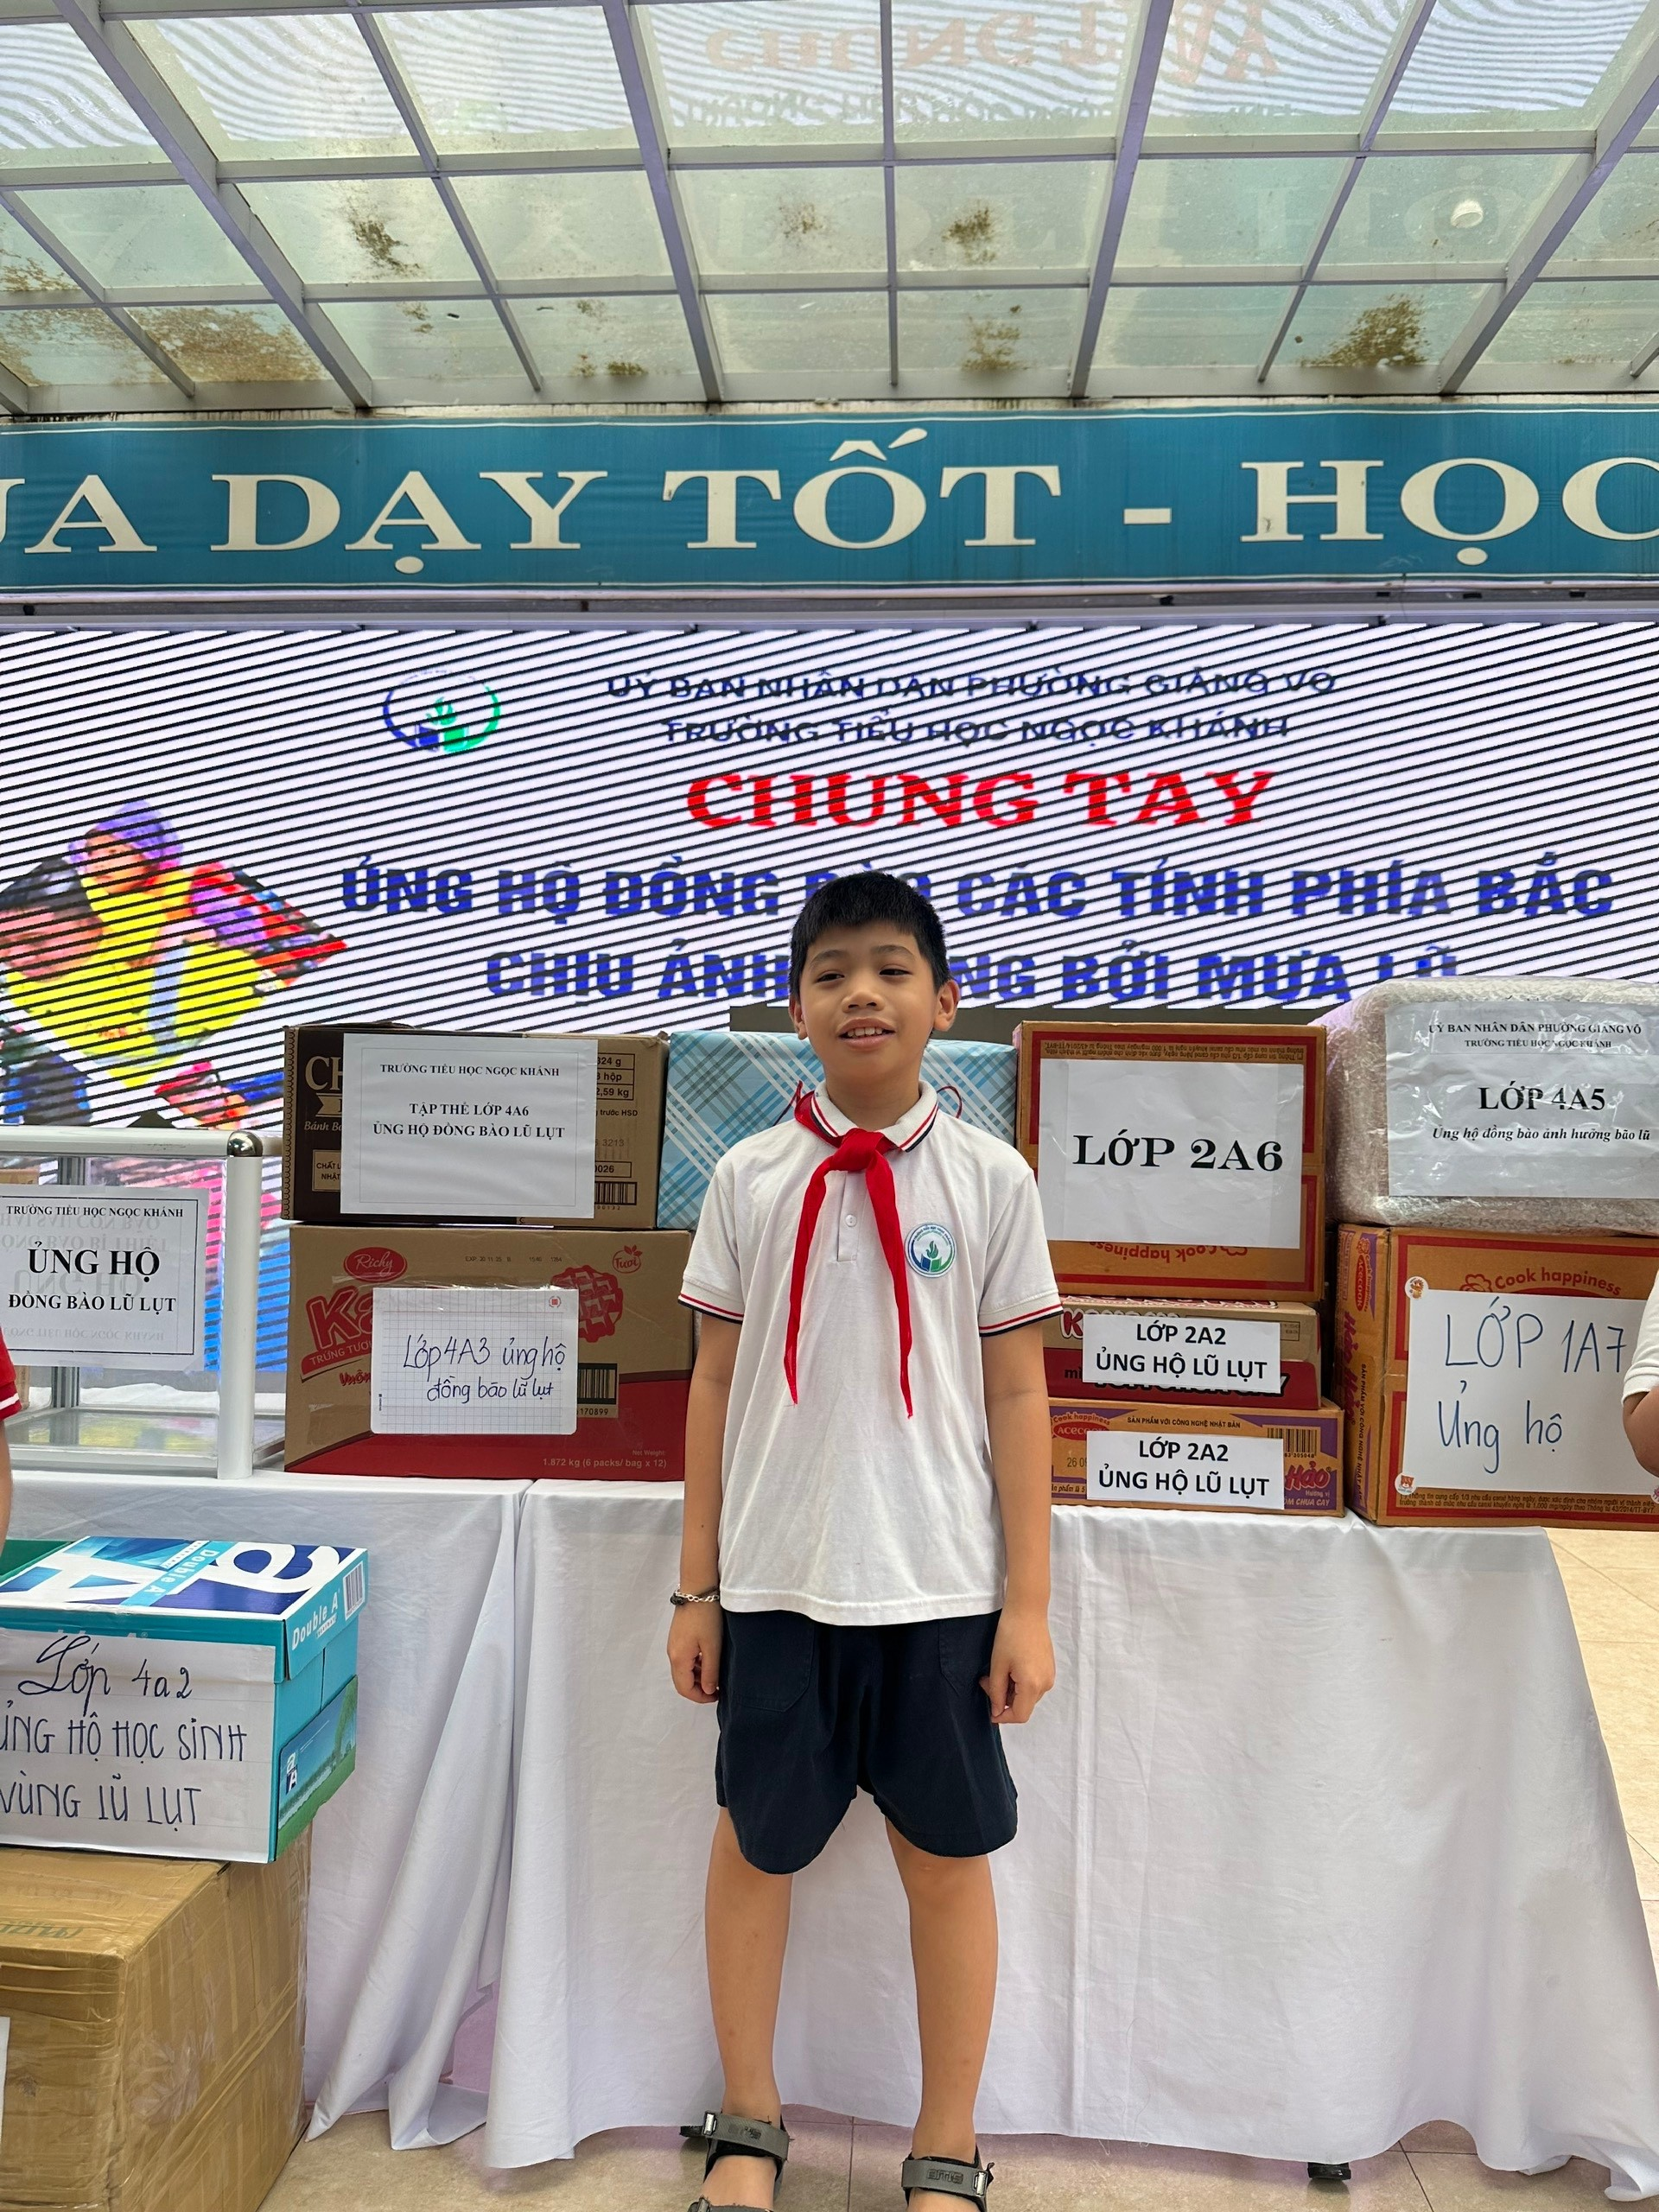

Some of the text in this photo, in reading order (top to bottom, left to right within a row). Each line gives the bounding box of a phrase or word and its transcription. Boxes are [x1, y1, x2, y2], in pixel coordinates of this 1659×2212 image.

[211, 470, 608, 575] DẠY
[661, 427, 1061, 550] TỐT
[1241, 457, 1659, 566] HỌC
[668, 677, 746, 699] BAN
[758, 669, 865, 699] NHÂN
[967, 667, 1130, 696] PHƯỜNG
[664, 709, 1288, 747] TRƯỜNG TIỂU HỌC NGỌC KHÁNH
[688, 770, 1278, 829] CHUNG TAY
[495, 862, 582, 924] HỘ
[604, 855, 780, 917] ĐỒNG
[957, 862, 1086, 916] CÁC
[1292, 861, 1452, 916] PHÍA
[1476, 851, 1614, 917] BẮC
[1060, 940, 1169, 1001] BỞI
[1197, 950, 1352, 1002] MƯA
[1447, 1024, 1471, 1033] BAN
[1474, 1020, 1507, 1033] NHÂN
[1510, 1020, 1535, 1033] DÂN
[1538, 1021, 1586, 1033] PHƯỜNG
[1627, 1023, 1642, 1034] VÕ
[1465, 1037, 1504, 1047] TRƯỜNG
[1531, 1039, 1551, 1049] HỌC
[380, 1063, 428, 1074] TRƯỜNG
[458, 1065, 483, 1077] HỌC
[486, 1066, 518, 1077] NGỌC
[519, 1065, 560, 1077] KHÁNH
[615, 1058, 621, 1067] g
[604, 1072, 622, 1085] hộp
[596, 1087, 630, 1099] 2,59 kg
[1478, 1080, 1605, 1111] LỚP 4A5
[410, 1102, 438, 1117] TẬP
[474, 1102, 502, 1116] LỚP
[505, 1105, 530, 1116] 4A6
[304, 1121, 329, 1131] Bánh
[373, 1121, 565, 1141] ỦNG HỘ ĐỒNG BÀO LŨ LỤT
[1463, 1127, 1479, 1141] hộ
[1483, 1124, 1514, 1141] đồng
[1516, 1128, 1539, 1139] bào
[1571, 1128, 1611, 1142] hưởng
[1614, 1128, 1636, 1140] bão
[1638, 1128, 1651, 1140] lũ
[1071, 1128, 1284, 1172] LỚP 2A6
[316, 1160, 336, 1170] CHẤT
[6, 1204, 53, 1216] TRƯỜNG
[83, 1207, 107, 1218] HỌC
[109, 1207, 142, 1219] NGỌC
[143, 1205, 184, 1217] KHÁNH
[28, 1240, 161, 1283] ỦNG HỘ
[353, 1250, 395, 1277] Richy
[1495, 1266, 1622, 1296] Cook happiness
[9, 1290, 177, 1316] ĐỒNG BÀO LŨ LỤT
[1136, 1320, 1227, 1345] LỚP 2A2
[1445, 1295, 1627, 1374] LỚP 1A7
[309, 1344, 346, 1366] TRỨNG
[404, 1333, 442, 1382] Lớp
[443, 1336, 491, 1365] 4A3
[542, 1336, 567, 1371] hộ
[1096, 1346, 1268, 1382] ỦNG HỘ LŨ LỤT
[426, 1375, 471, 1404] đồng
[512, 1377, 528, 1399] lũ
[531, 1377, 554, 1401] lụt
[1053, 1412, 1110, 1425] Cook happiness
[1172, 1418, 1190, 1427] CÔNG
[1191, 1419, 1208, 1427] NGHỆ
[1526, 1399, 1563, 1452] hộ
[1139, 1436, 1229, 1462] LỚP 2A2
[543, 1458, 567, 1466] 1.872
[569, 1459, 581, 1468] kg
[582, 1459, 591, 1467] (6
[594, 1459, 623, 1468] packs/
[625, 1459, 642, 1469] bag
[653, 1459, 667, 1468] 12)
[1098, 1463, 1270, 1500] ỦNG HỘ LŨ LỤT
[291, 1605, 327, 1651] Double
[331, 1592, 338, 1614] A
[17, 1634, 194, 1718] Lớp 4a2
[68, 1712, 102, 1762] HỘ
[111, 1719, 165, 1764] HỌC
[0, 1770, 81, 1819] VÙNG
[146, 1785, 202, 1833] LỤT
